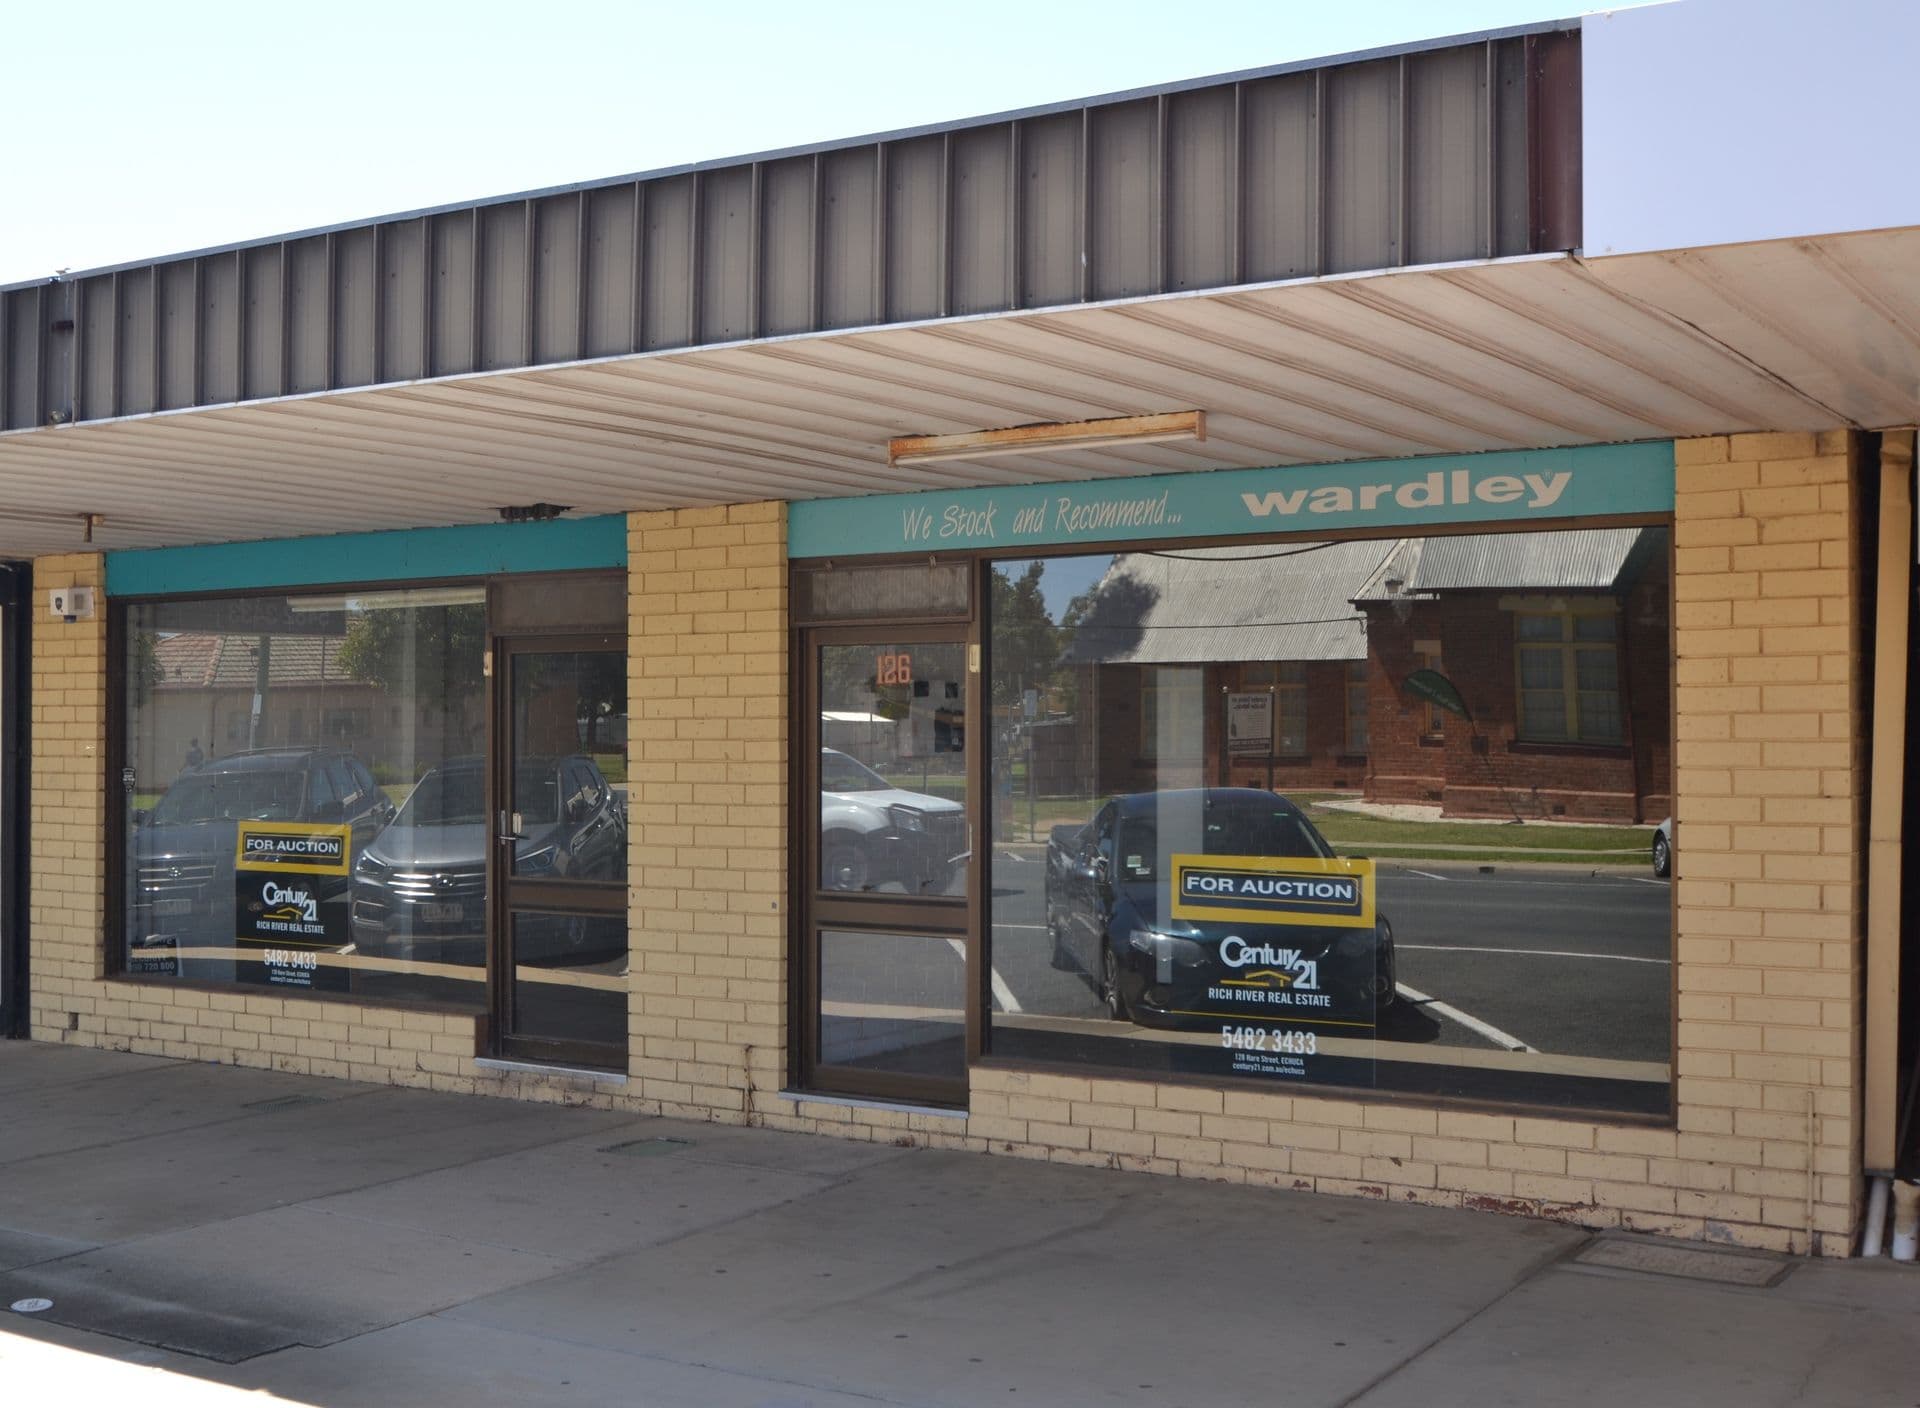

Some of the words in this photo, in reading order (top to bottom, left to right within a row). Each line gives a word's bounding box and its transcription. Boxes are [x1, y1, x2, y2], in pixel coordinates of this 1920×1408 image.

[1240, 469, 1573, 517] wardley
[902, 507, 933, 542] We
[939, 500, 998, 538] Stock
[1012, 499, 1048, 535] and
[876, 655, 911, 685] 126
[246, 838, 274, 852] FOR
[277, 839, 339, 854] AUCTION
[1186, 876, 1234, 893] FOR
[1241, 879, 1353, 900] AUCTION
[302, 899, 318, 922] 21
[271, 921, 288, 932] RIVER
[289, 922, 304, 933] REAL
[304, 923, 325, 935] ESTATE
[263, 949, 289, 968] 5482
[291, 951, 317, 970] 3433
[1292, 959, 1318, 990] 21
[1208, 986, 1232, 1001] RICH
[1235, 988, 1265, 1003] RIVER
[1268, 991, 1293, 1005] REAL
[1295, 993, 1331, 1007] ESTATE
[1222, 1025, 1266, 1052] 5482
[1272, 1029, 1317, 1056] 3433
